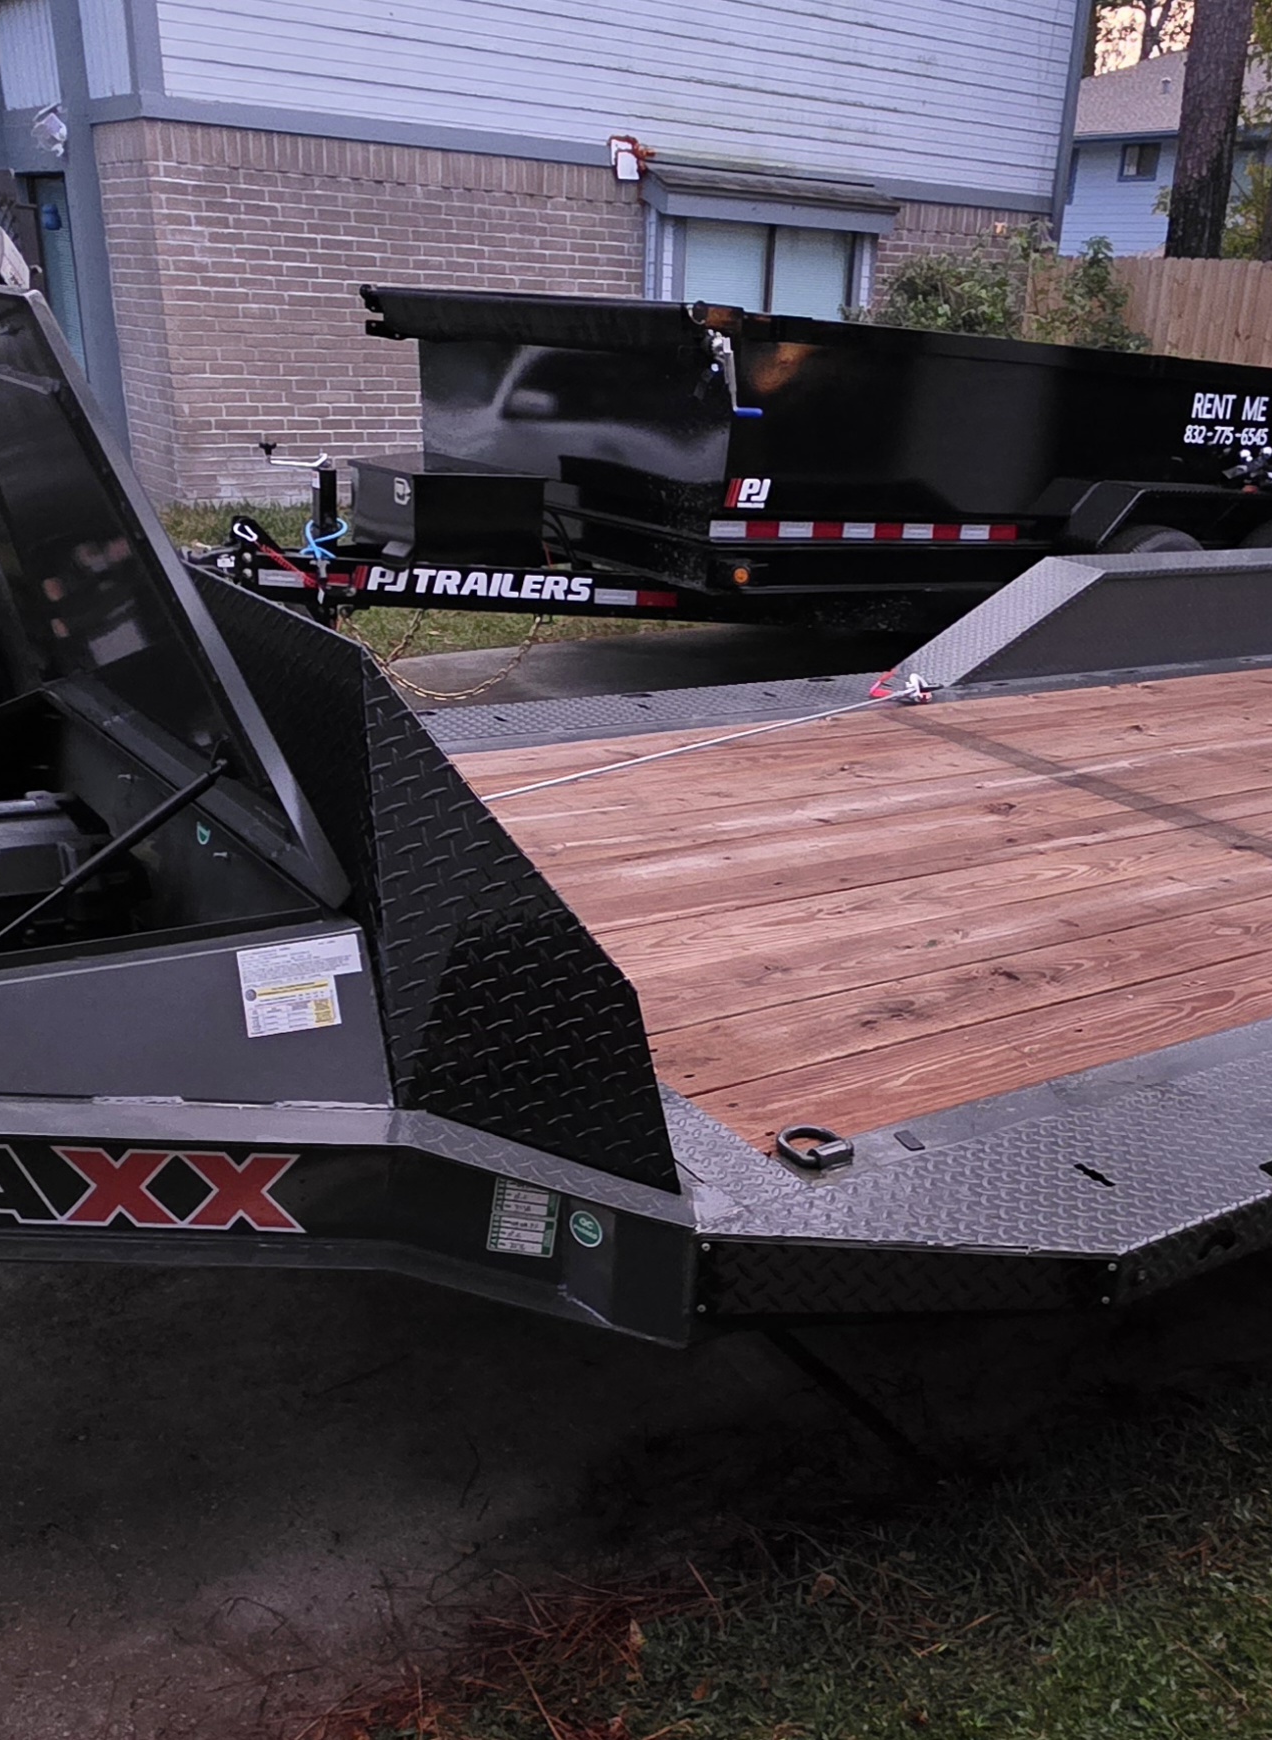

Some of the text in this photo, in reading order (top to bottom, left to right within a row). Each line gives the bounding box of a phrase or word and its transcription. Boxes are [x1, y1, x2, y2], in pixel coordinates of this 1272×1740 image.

[1191, 392, 1270, 422] RENT ME
[1183, 424, 1269, 446] 832-775-6545
[737, 477, 772, 502] PJ
[366, 566, 593, 602] PJ TRAILERS
